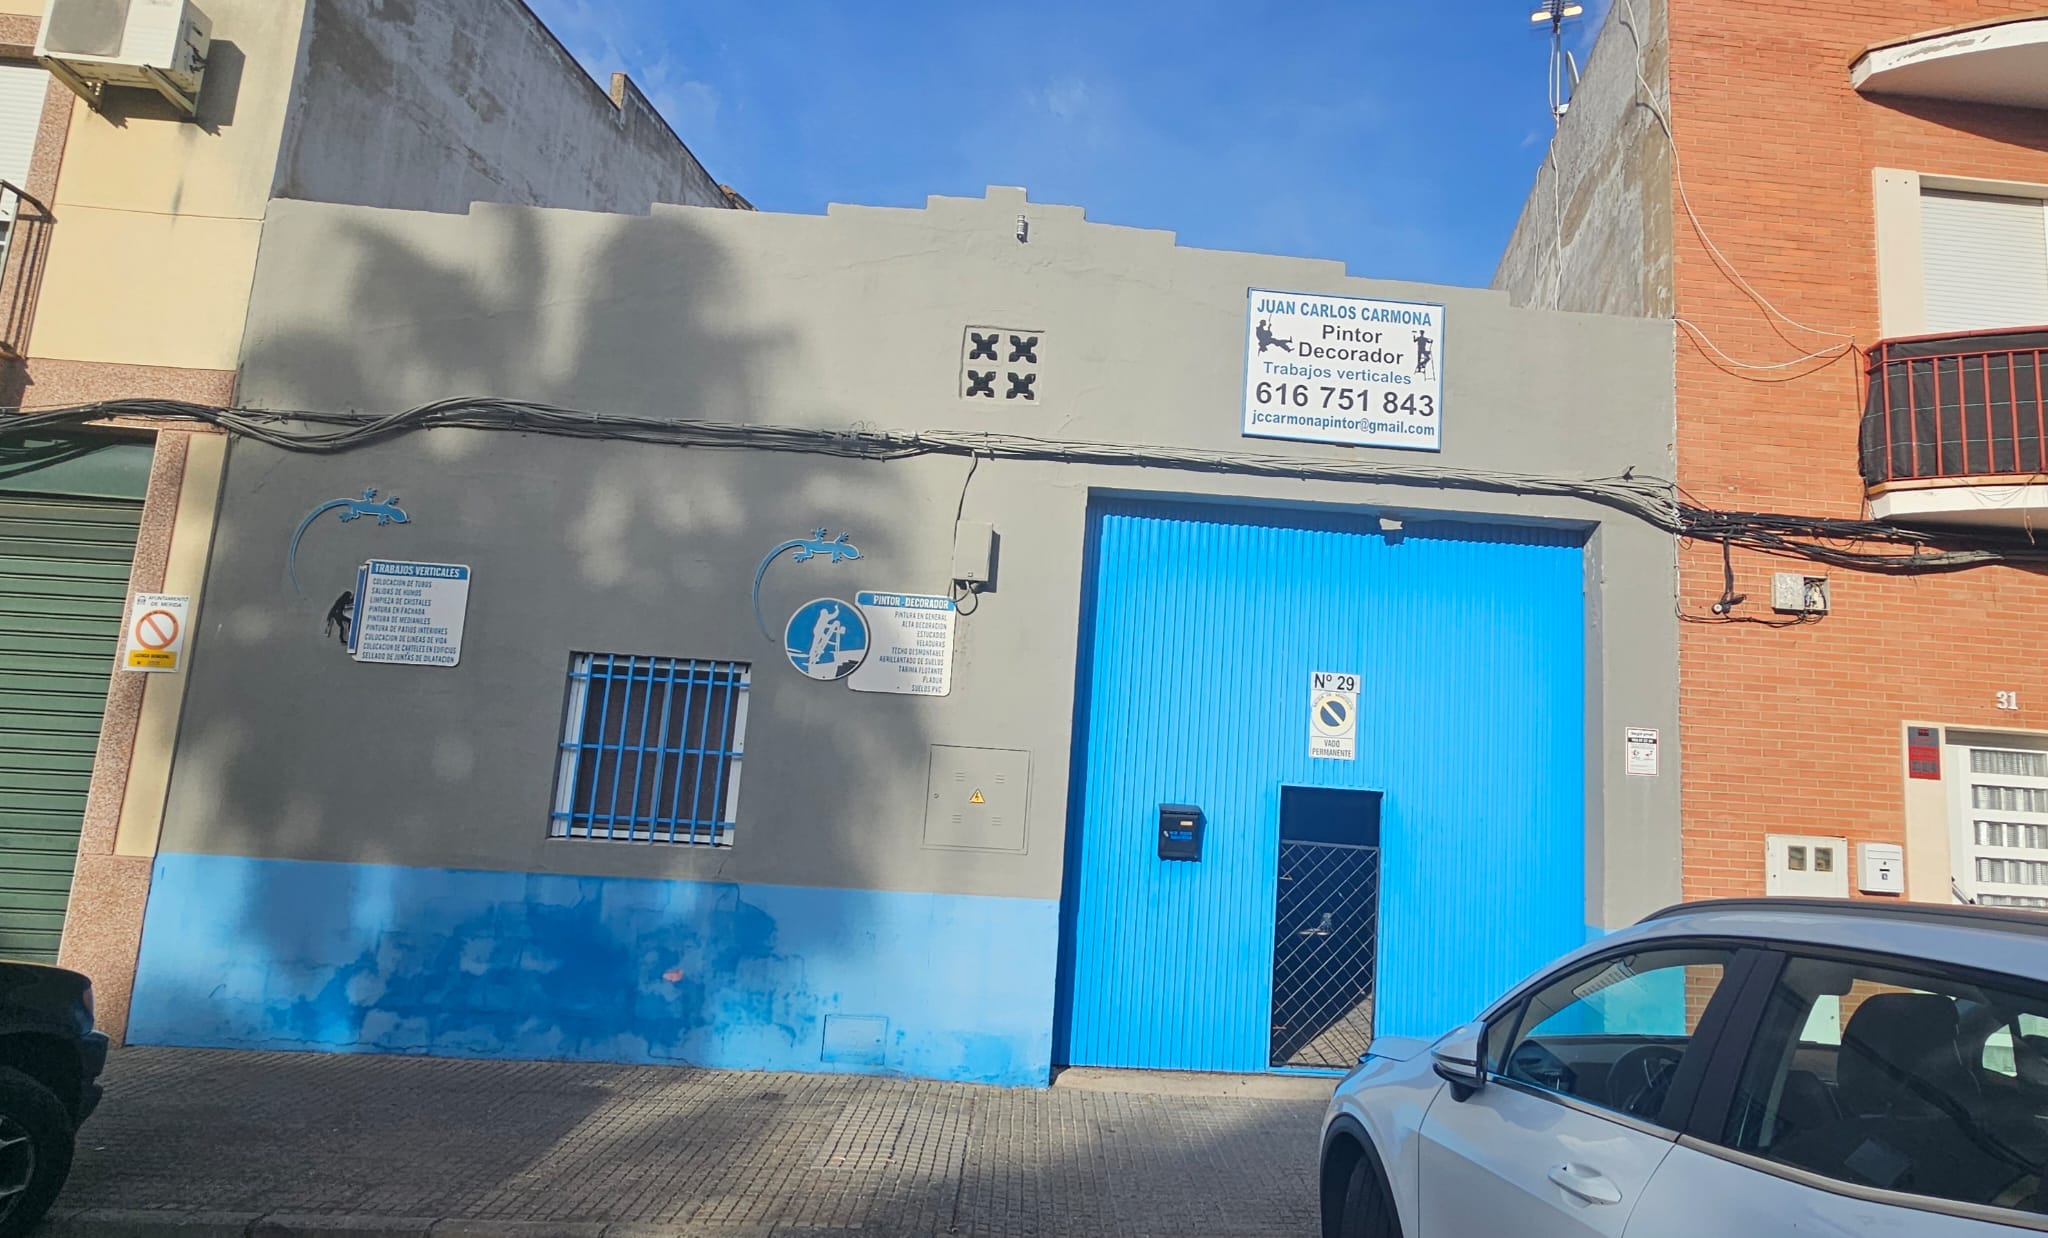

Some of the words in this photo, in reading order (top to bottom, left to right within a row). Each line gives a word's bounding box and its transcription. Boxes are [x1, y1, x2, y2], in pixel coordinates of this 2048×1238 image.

[1257, 299, 1295, 314] JUAN
[1300, 302, 1356, 319] CARLOS
[1361, 307, 1432, 326] CARMONA
[1322, 324, 1383, 344] Pintor
[1299, 342, 1404, 364] Decorador
[1264, 361, 1331, 380] Trabajos
[1337, 369, 1411, 385] verticales
[1256, 382, 1309, 407] 616
[1320, 386, 1369, 412] 751
[1383, 391, 1434, 417] 843
[1252, 410, 1435, 436] jccarmonapintor@gmail.com
[375, 563, 414, 575] TRABAJOS
[415, 566, 460, 578] VERTICALES
[373, 578, 406, 586] COLOCACION
[371, 587, 393, 595] SALIDAS
[395, 588, 401, 596] DE
[403, 589, 422, 597] HUMOS
[370, 596, 394, 605] LIMPIEZA
[395, 597, 402, 605] DE
[403, 598, 432, 606] CRISTALES
[873, 594, 900, 606] PINTOR
[905, 597, 949, 609] DECORADOR
[368, 605, 391, 613] PINTURA
[392, 606, 399, 614] EN
[400, 607, 425, 615] FACHADA
[894, 610, 916, 619] PINTURA
[917, 612, 924, 620] EN
[925, 613, 947, 621] GENERAL
[366, 624, 388, 632] PINTURA
[397, 626, 417, 634] PATIOS
[418, 627, 448, 635] INTERIORES
[902, 620, 914, 628] ALTA
[915, 621, 947, 630] DECORACION
[364, 633, 398, 641] COLOCACION
[917, 630, 946, 639] ESTUCADOS
[363, 642, 393, 650] COLOCACION
[401, 644, 425, 653] CARTELES
[426, 645, 432, 653] EN
[916, 639, 946, 648] VELADURAS
[362, 651, 386, 659] SELLADO
[395, 653, 414, 661] JUNTAS
[415, 654, 422, 662] DE
[423, 654, 454, 663] DILATACION
[892, 646, 908, 655] TECHO
[908, 647, 944, 657] DESMONTABLE
[879, 655, 916, 664] ABRILLANTADO
[917, 657, 924, 665] DE
[925, 658, 944, 666] SUELOS
[918, 666, 943, 675] FLOTANTE
[922, 676, 943, 684] PLADUR
[1337, 676, 1355, 691] 29
[911, 684, 931, 692] SUELOS
[1996, 690, 2018, 710] 31
[1324, 739, 1340, 748] VADO
[1312, 748, 1352, 757] PERMANENTE
